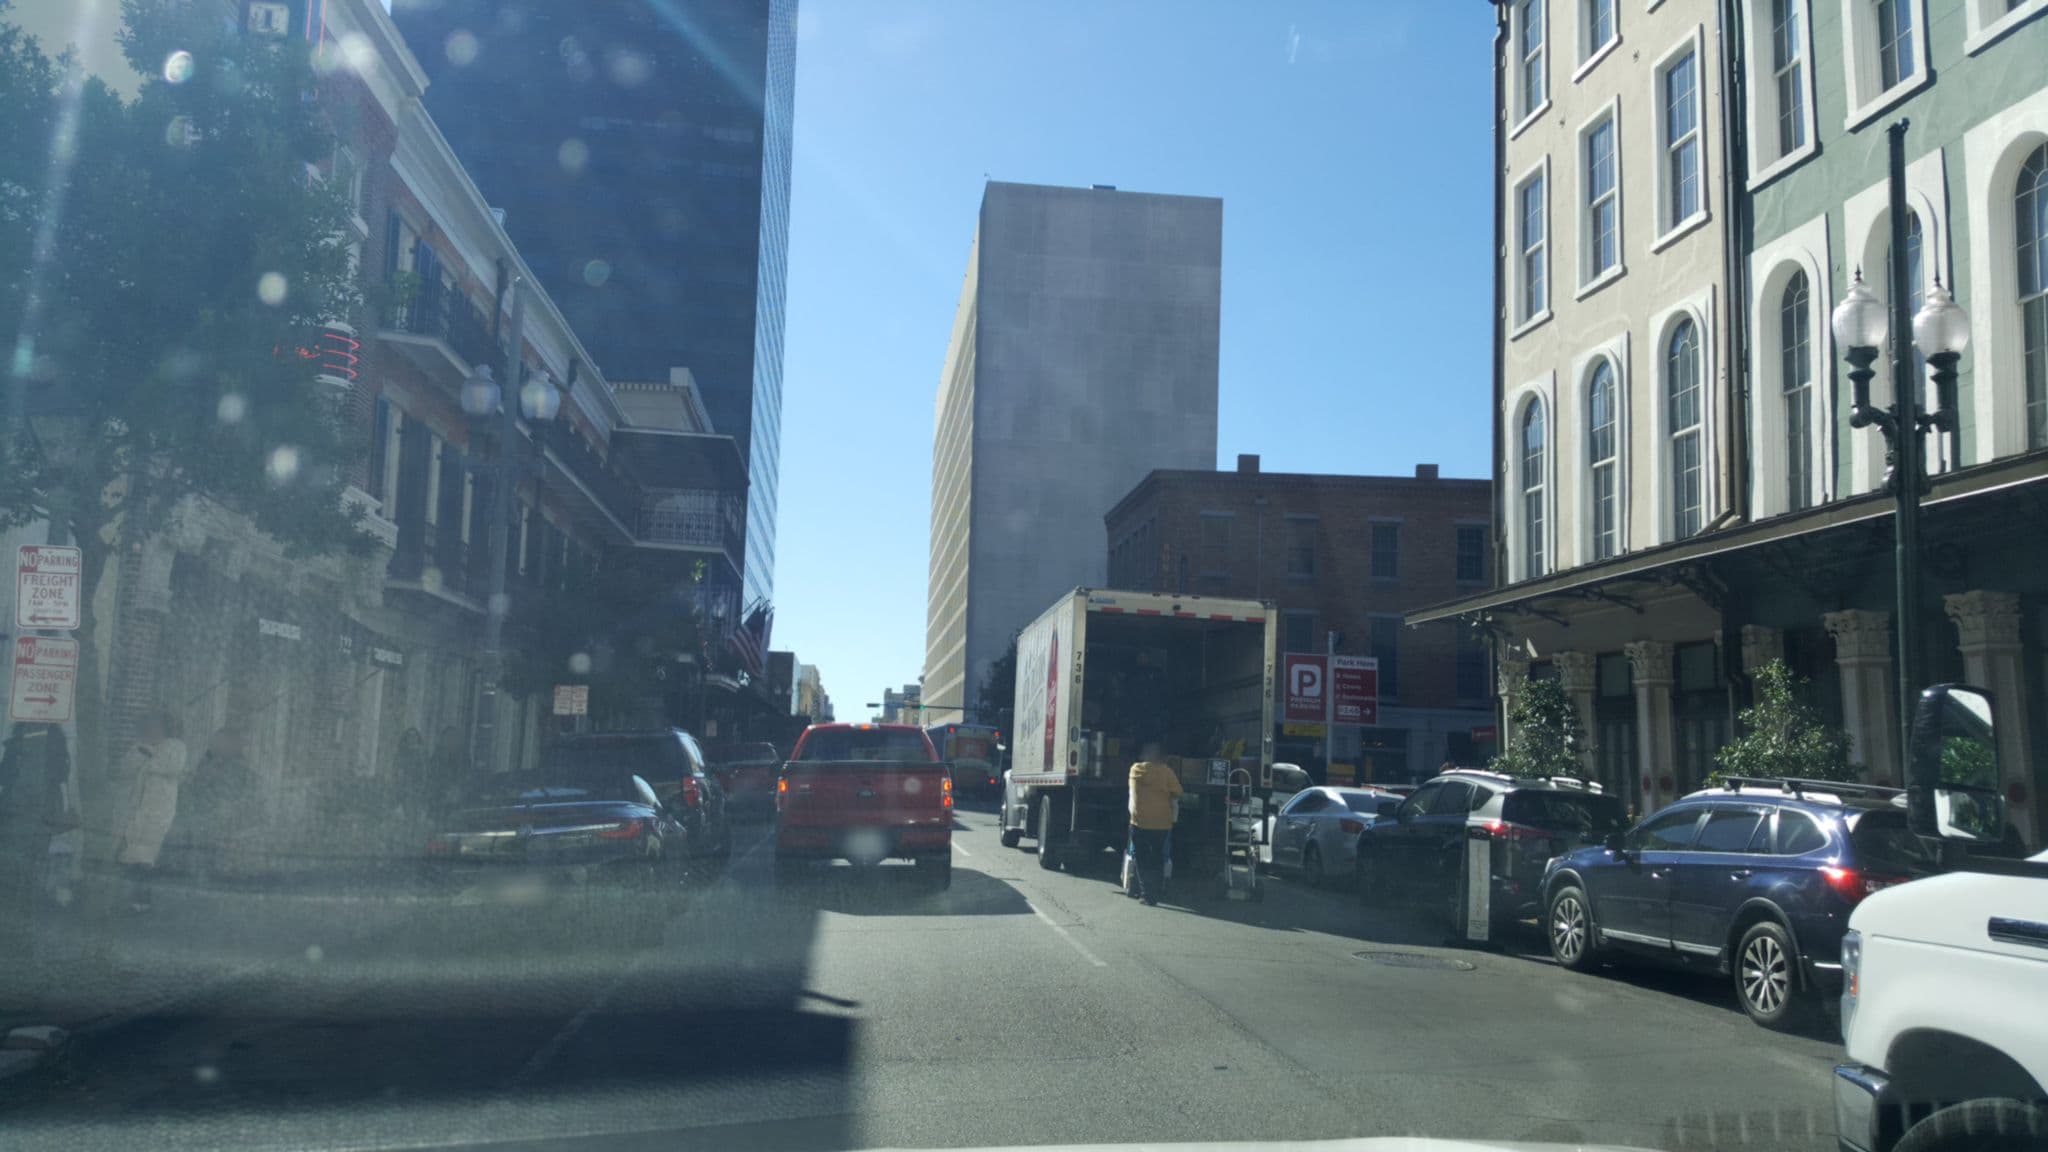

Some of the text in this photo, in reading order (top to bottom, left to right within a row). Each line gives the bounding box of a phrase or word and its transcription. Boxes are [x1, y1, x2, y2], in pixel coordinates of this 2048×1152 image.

[20, 551, 78, 568] NO PARKING
[23, 574, 73, 587] FREIGHT
[32, 587, 64, 600] ZONE
[17, 643, 74, 659] NO PARKING
[17, 667, 72, 681] PASSENGER
[27, 682, 59, 694] ZONE
